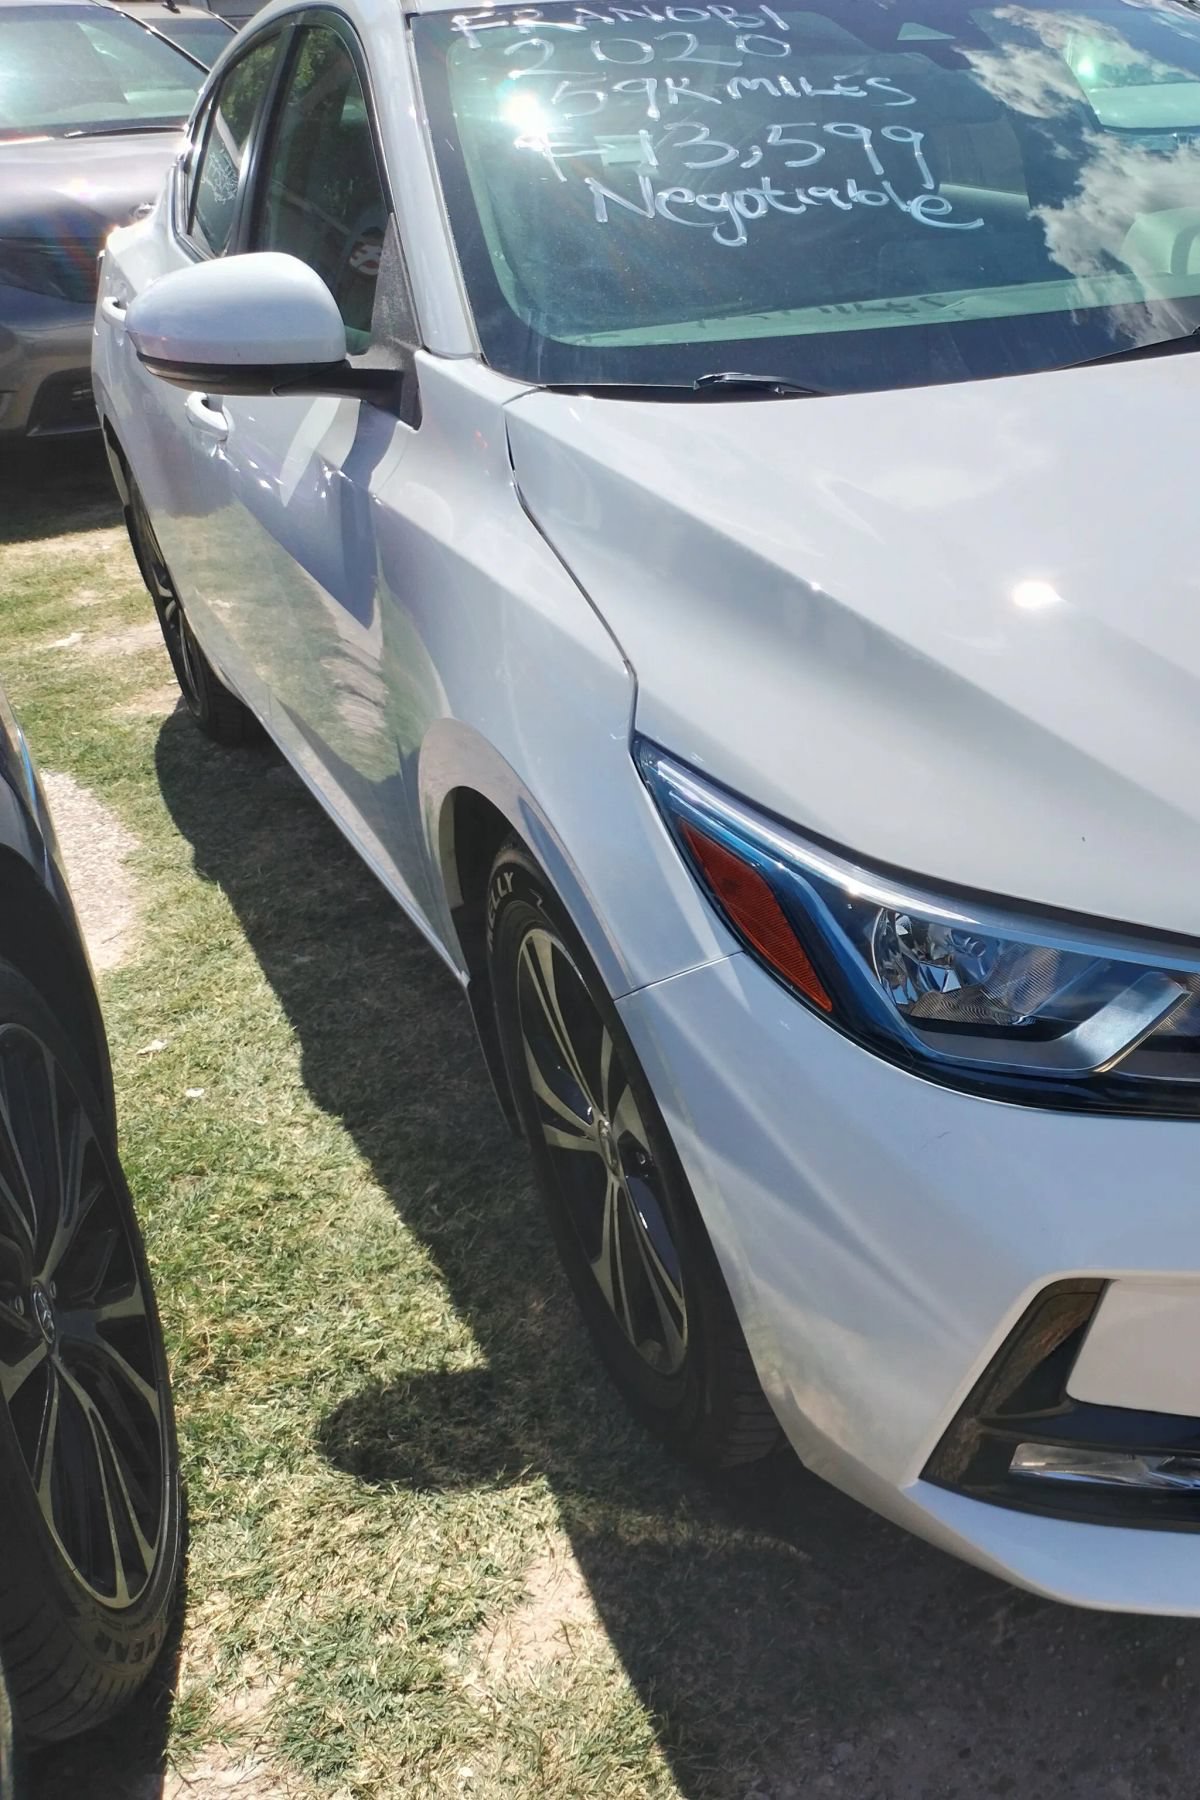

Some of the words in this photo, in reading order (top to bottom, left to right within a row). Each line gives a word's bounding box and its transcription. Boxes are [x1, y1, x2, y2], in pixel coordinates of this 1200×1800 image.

[503, 31, 792, 79] 2020
[550, 75, 722, 121] 59K
[584, 175, 985, 247] Negotiable
